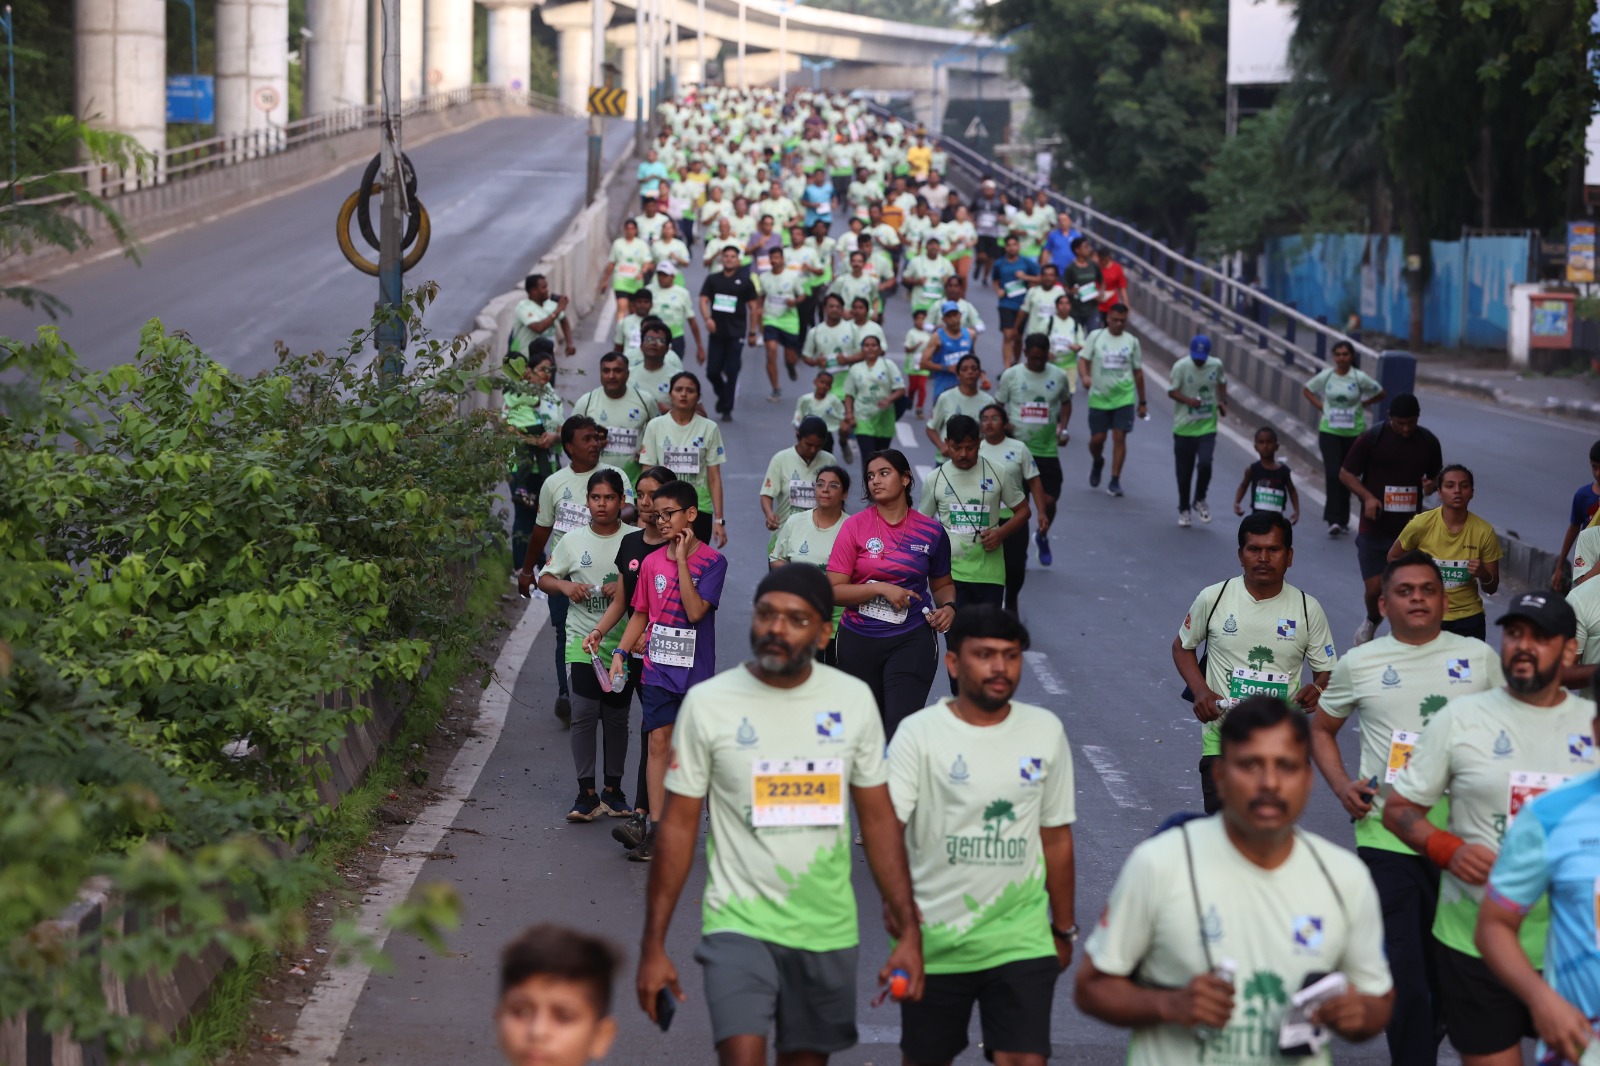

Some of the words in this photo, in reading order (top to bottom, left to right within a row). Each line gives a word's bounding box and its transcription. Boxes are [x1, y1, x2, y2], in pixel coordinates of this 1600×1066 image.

[563, 512, 588, 524] 30346
[1440, 570, 1463, 579] 2142
[655, 639, 685, 651] 31531
[1240, 684, 1278, 697] 50510
[768, 782, 826, 797] 22324
